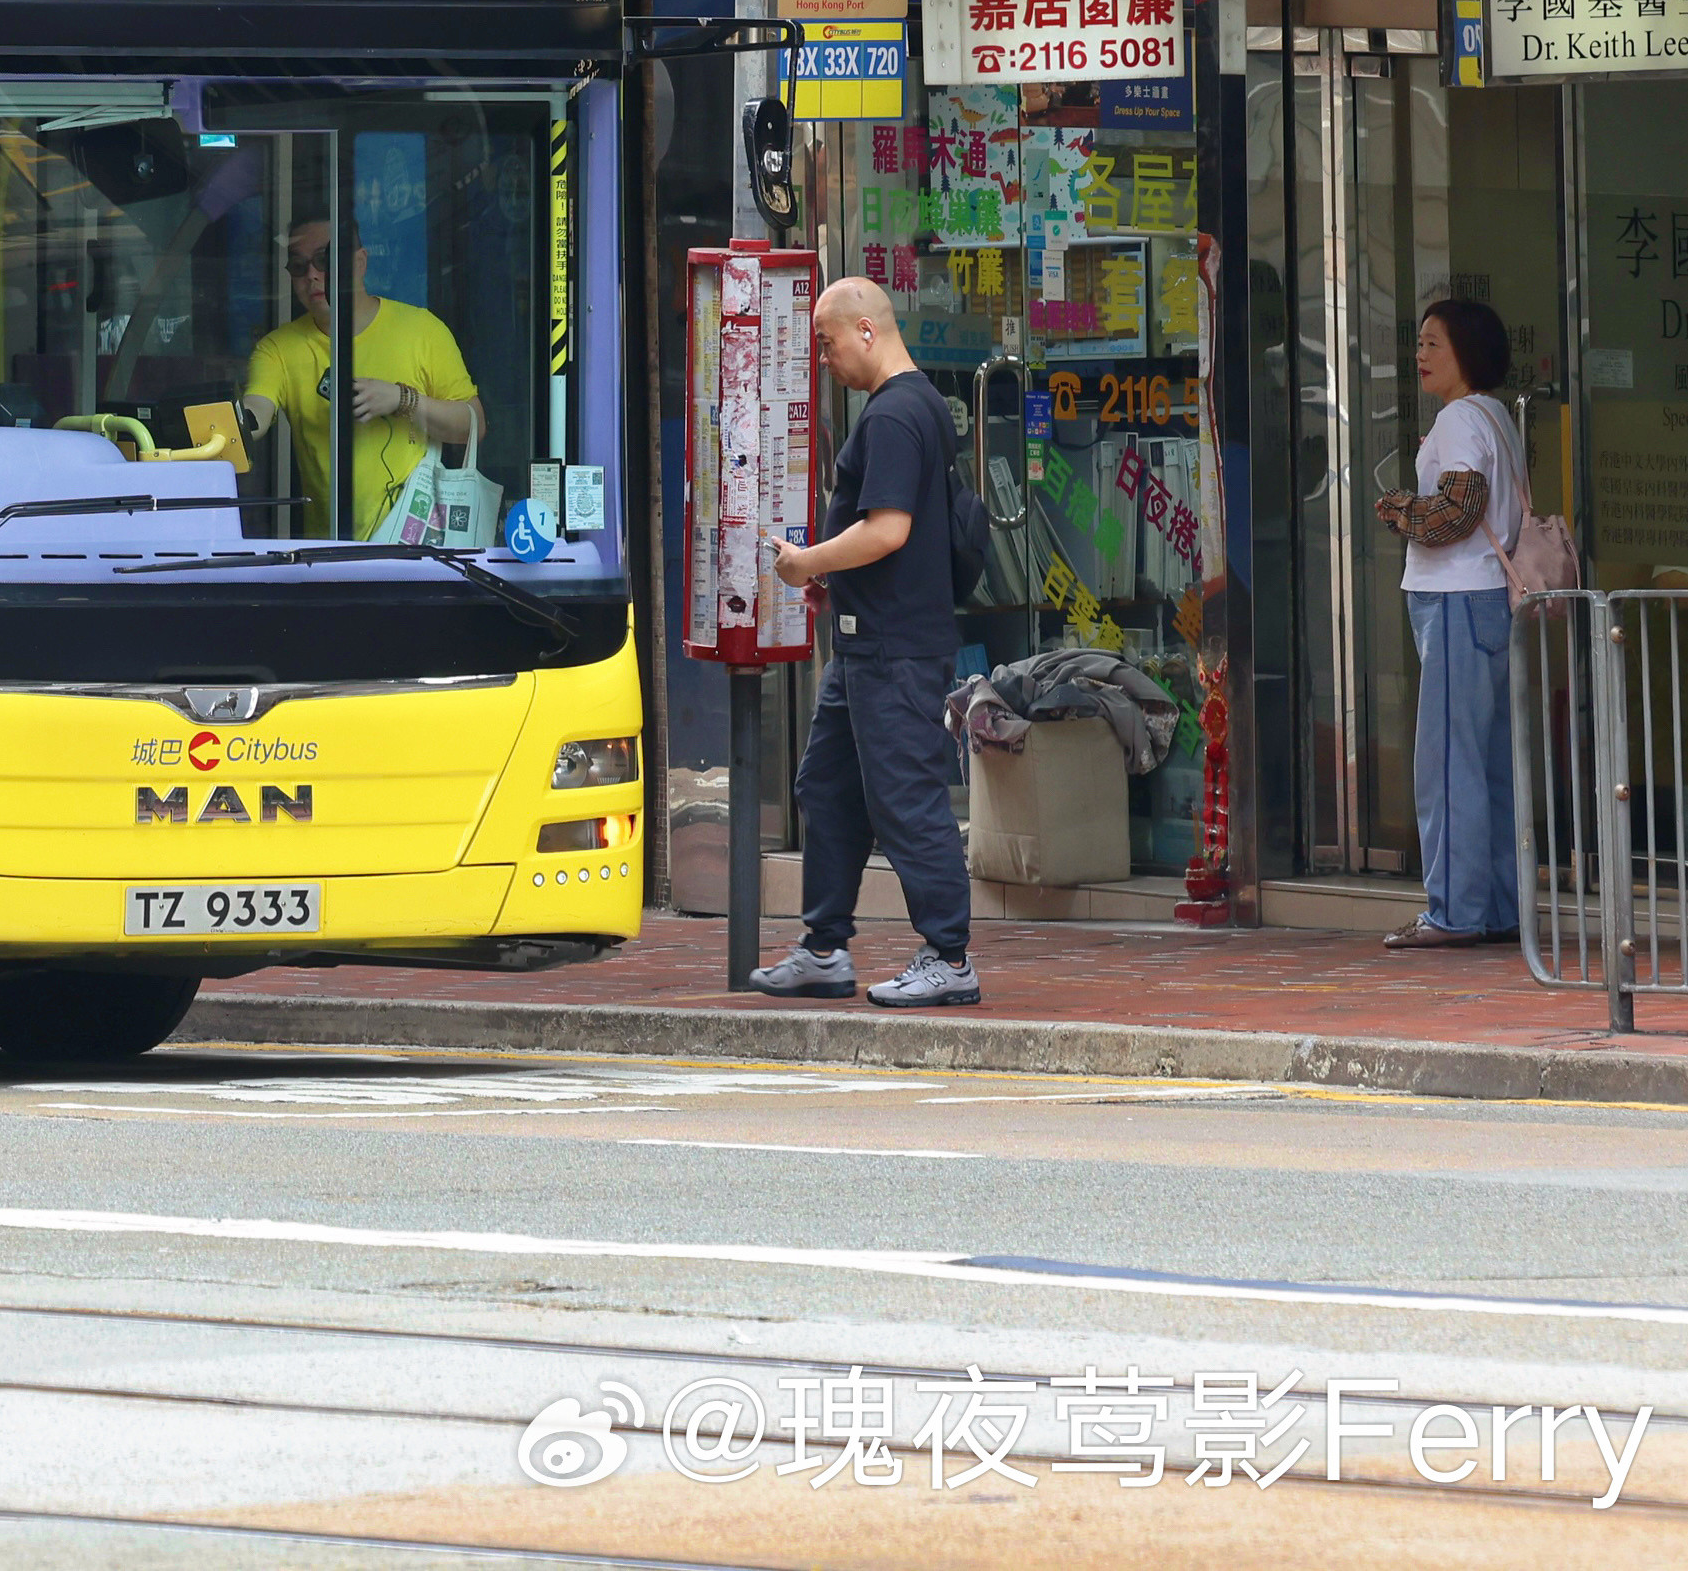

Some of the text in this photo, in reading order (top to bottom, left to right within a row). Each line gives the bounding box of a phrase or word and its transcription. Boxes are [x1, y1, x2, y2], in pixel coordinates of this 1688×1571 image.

[796, 0, 864, 13] Hong Kong Port
[824, 45, 860, 77] 33X
[867, 46, 898, 76] 720
[1099, 37, 1176, 68] 5081
[1522, 34, 1558, 61] Dr.
[1567, 30, 1636, 60] Keith
[1160, 107, 1181, 119] Space
[794, 282, 809, 295] A12
[1003, 344, 1019, 354] PUSH
[1099, 373, 1170, 426] 2116
[539, 512, 545, 526] 1
[1115, 447, 1202, 574] 日夜捲
[131, 736, 318, 767] 城巴 Citybus
[135, 784, 314, 826] MAN
[135, 890, 311, 928] TZ 9333
